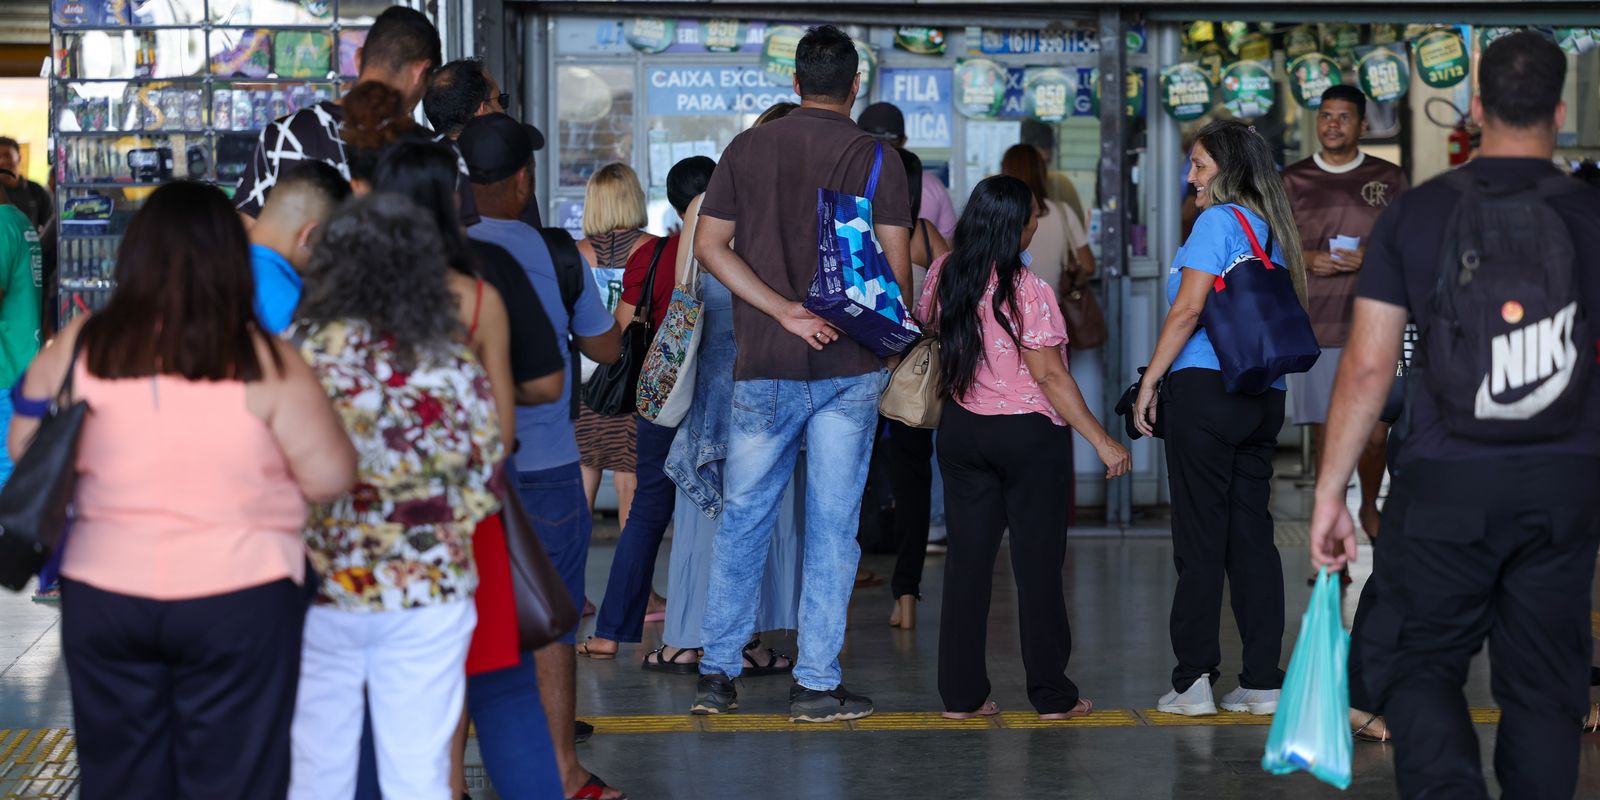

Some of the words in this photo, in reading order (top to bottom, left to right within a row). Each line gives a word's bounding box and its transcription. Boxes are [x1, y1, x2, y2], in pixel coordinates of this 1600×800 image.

[651, 70, 715, 88] CAIXA
[719, 70, 773, 88] EXCL
[1367, 60, 1399, 88] 850
[1427, 65, 1465, 83] 31/12
[894, 75, 940, 101] FILA
[677, 93, 727, 111] PARA
[905, 112, 950, 140] NICA
